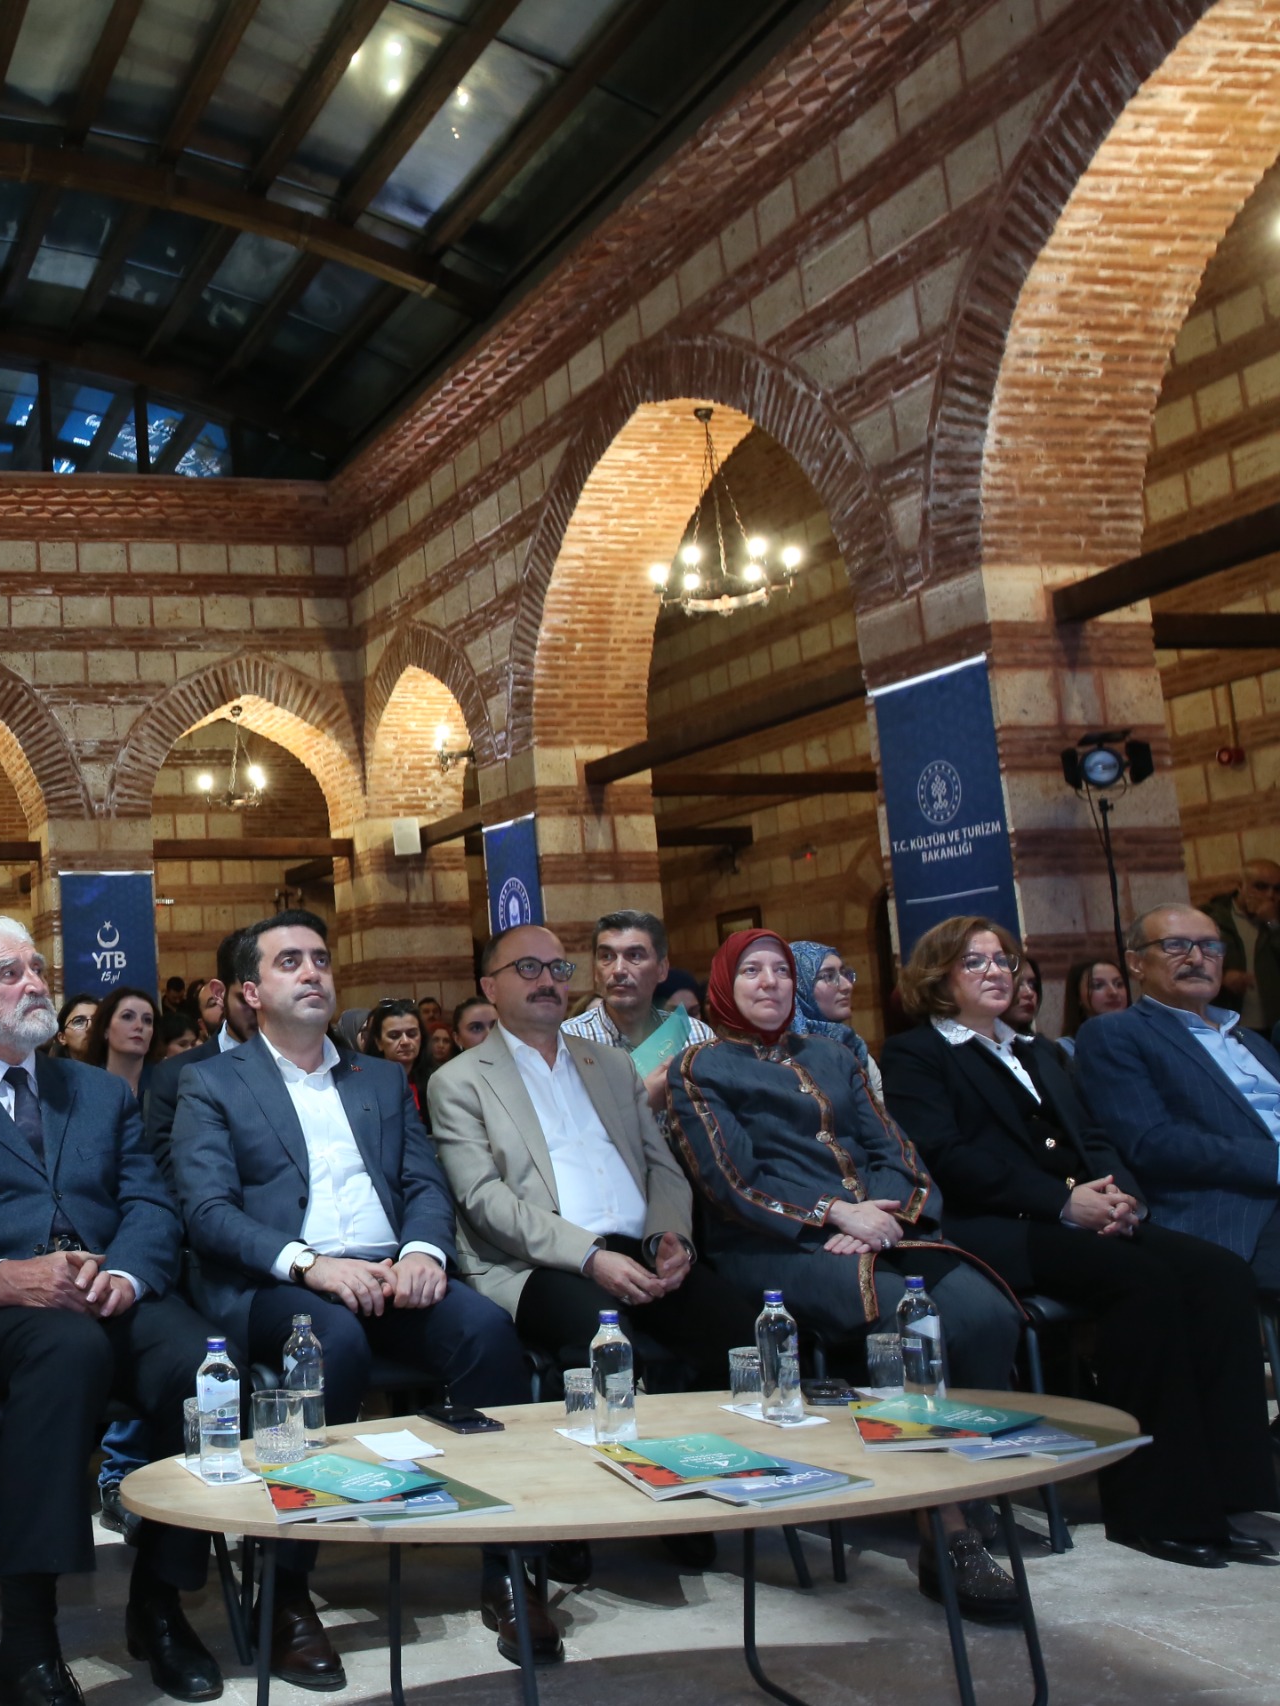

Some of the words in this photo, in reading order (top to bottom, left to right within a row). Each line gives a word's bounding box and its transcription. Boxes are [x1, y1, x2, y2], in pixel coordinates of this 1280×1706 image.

[893, 842, 909, 853] T.C.
[910, 833, 946, 850] KÜLTÜR
[948, 829, 960, 842] VE
[962, 821, 1001, 838] TURİZM
[922, 842, 972, 863] BAKANLIĞI
[91, 951, 127, 969] YTB
